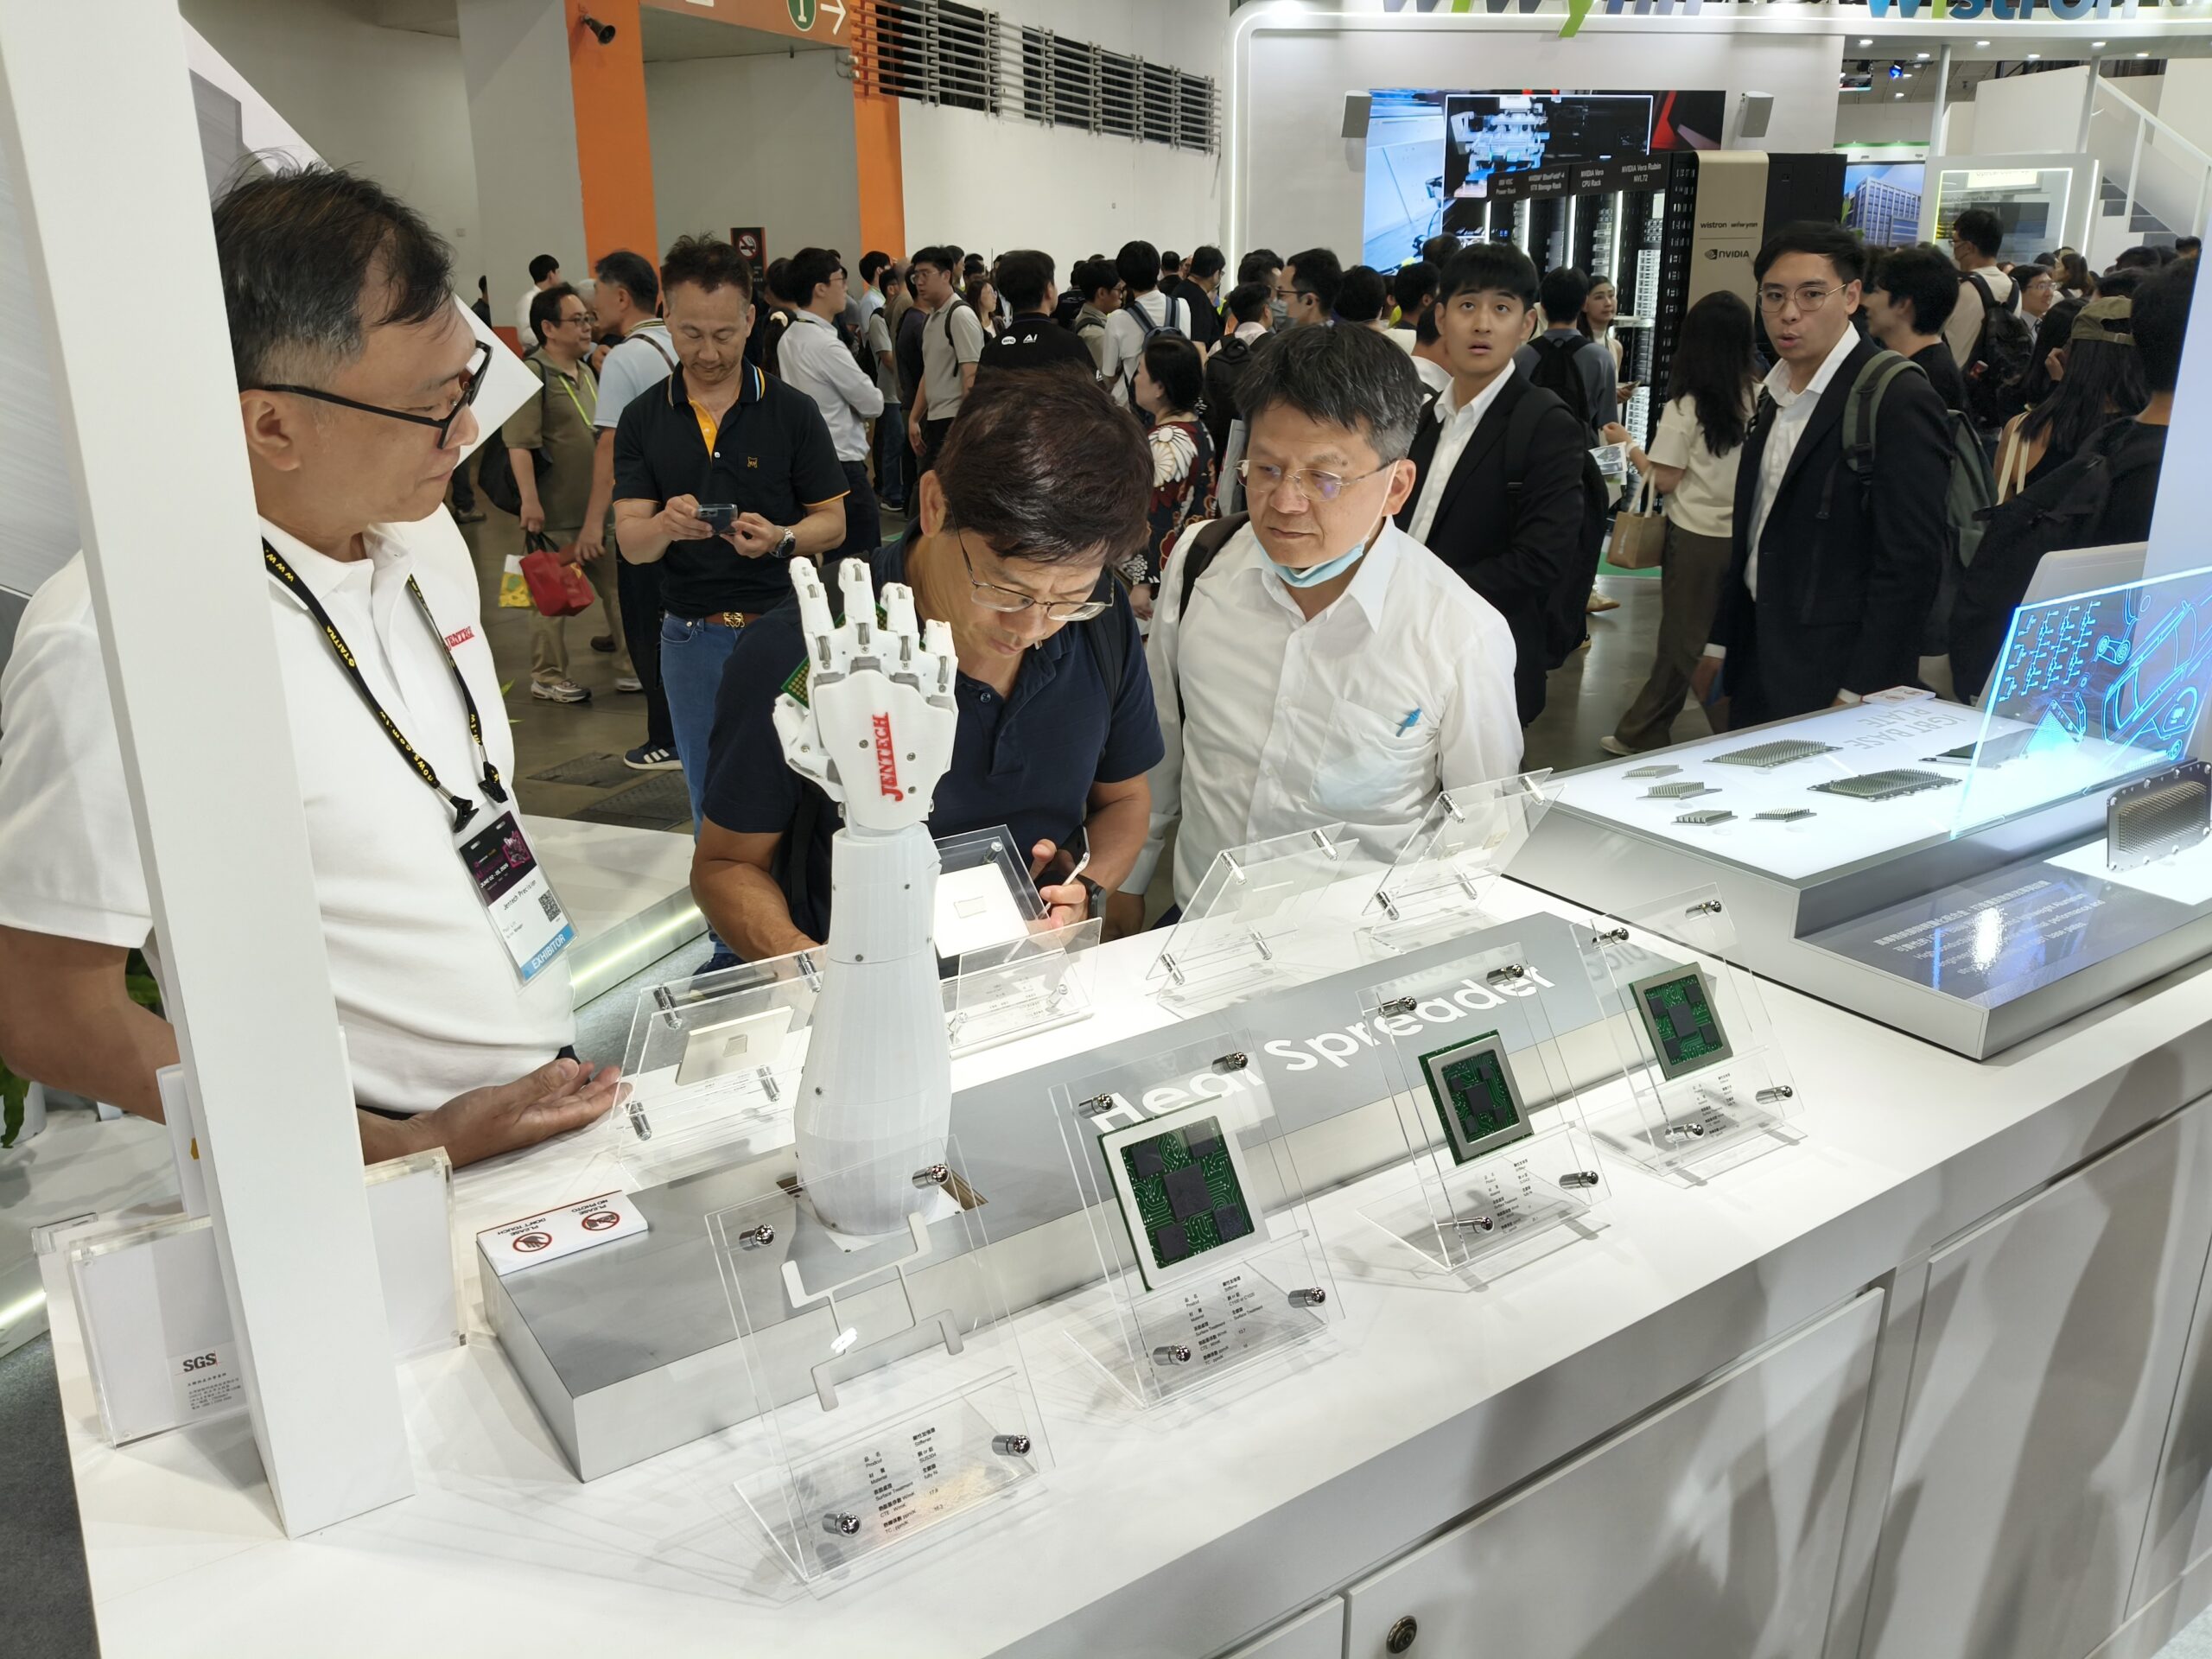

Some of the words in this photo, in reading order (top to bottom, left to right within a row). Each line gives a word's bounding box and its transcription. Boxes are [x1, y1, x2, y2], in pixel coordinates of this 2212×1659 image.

[325, 625, 350, 662] TAITRA
[1858, 706, 1932, 728] PLATE
[1904, 714, 1967, 734] IGBT
[1843, 728, 1915, 749] BASE
[872, 711, 904, 802] JENTECH
[480, 877, 490, 888] JUNE
[503, 895, 518, 911] Jentech
[518, 880, 537, 898] Precision
[531, 933, 566, 969] EXHIBITOR
[1263, 965, 1556, 1072] Spreader
[571, 1202, 598, 1213] PHOTO
[579, 1205, 607, 1216] PLEASE
[498, 1225, 523, 1236] TOUCH
[510, 1224, 539, 1236] PLEASE
[524, 1217, 546, 1228] DON'T
[1209, 1321, 1226, 1331] Treatment
[182, 1352, 217, 1372] SGS
[870, 1474, 888, 1484] Material
[875, 1491, 893, 1501] Surface
[893, 1481, 913, 1494] Treatment
[880, 1510, 890, 1518] CTE
